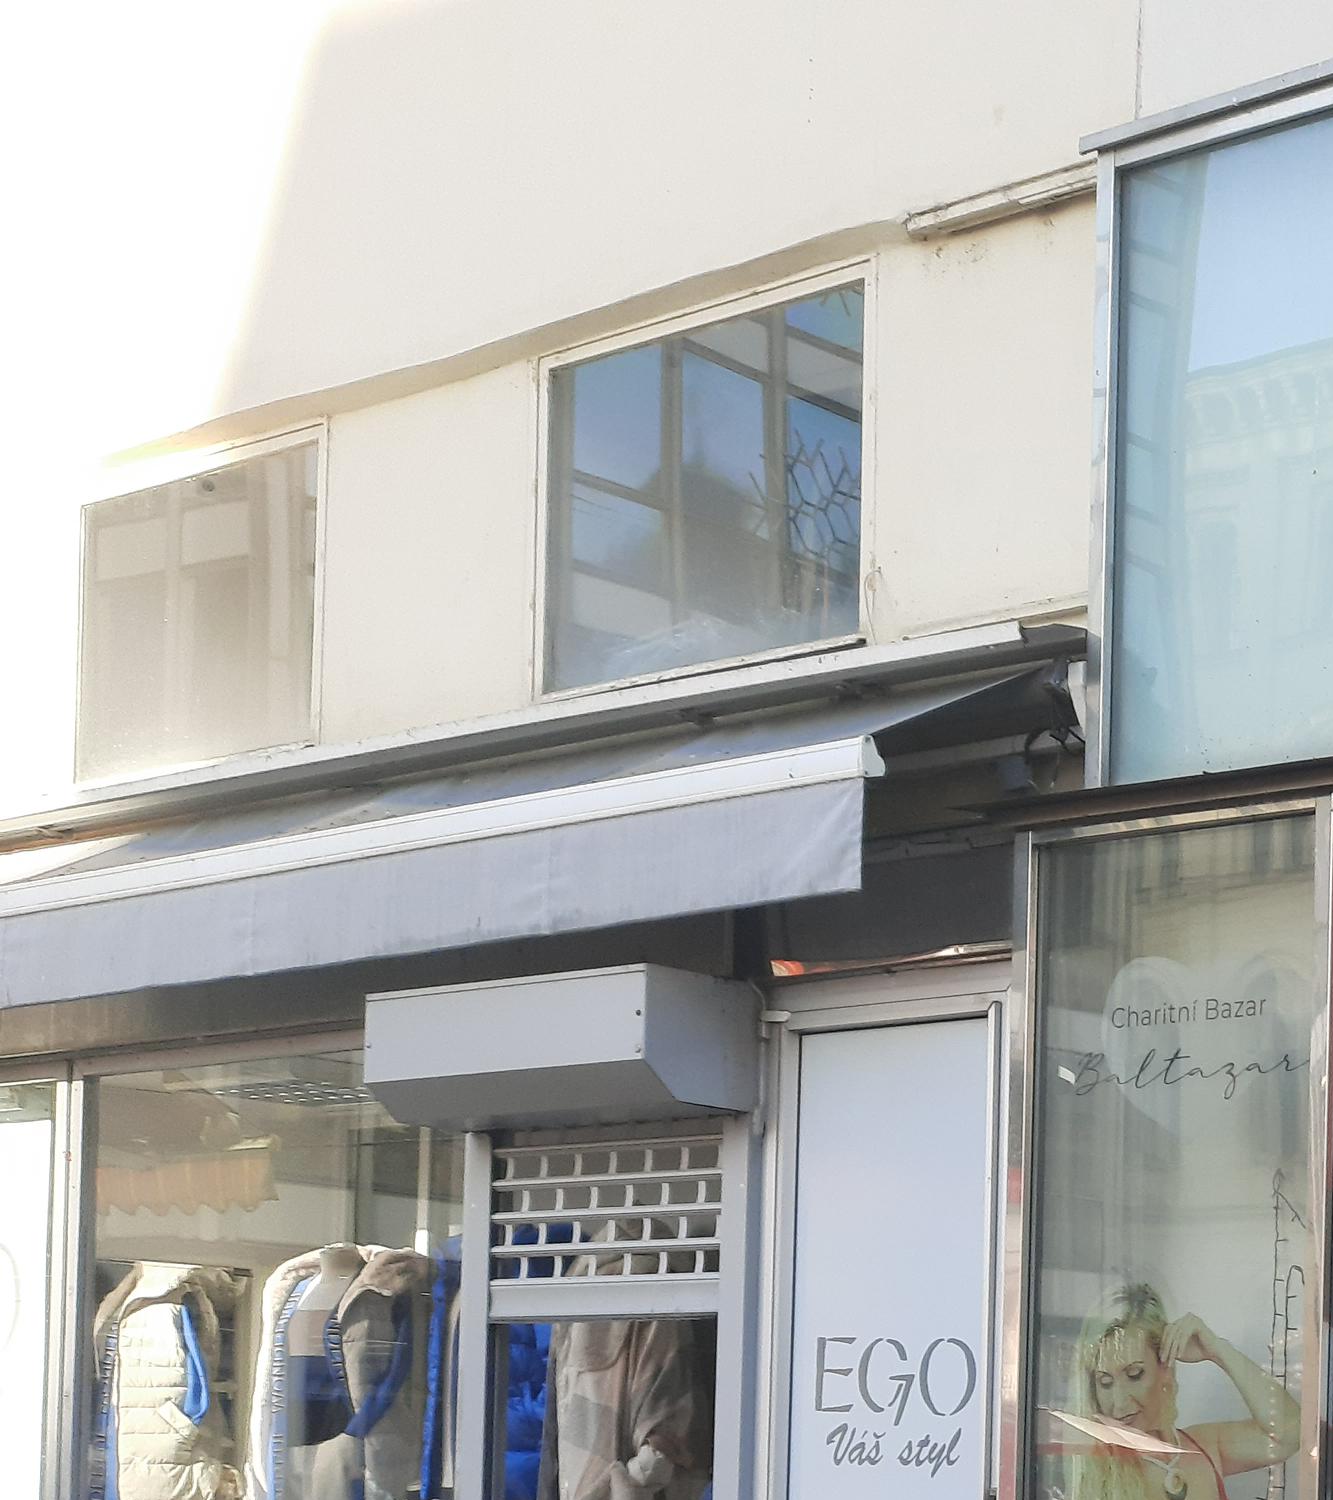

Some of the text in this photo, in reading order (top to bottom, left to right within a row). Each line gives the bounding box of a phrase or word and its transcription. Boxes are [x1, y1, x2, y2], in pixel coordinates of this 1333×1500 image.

[1111, 998, 1267, 1029] Charitní Bazar
[1075, 1046, 1311, 1100] Baltazar
[815, 1336, 977, 1427] EGO
[826, 1422, 962, 1478] Váš styl
